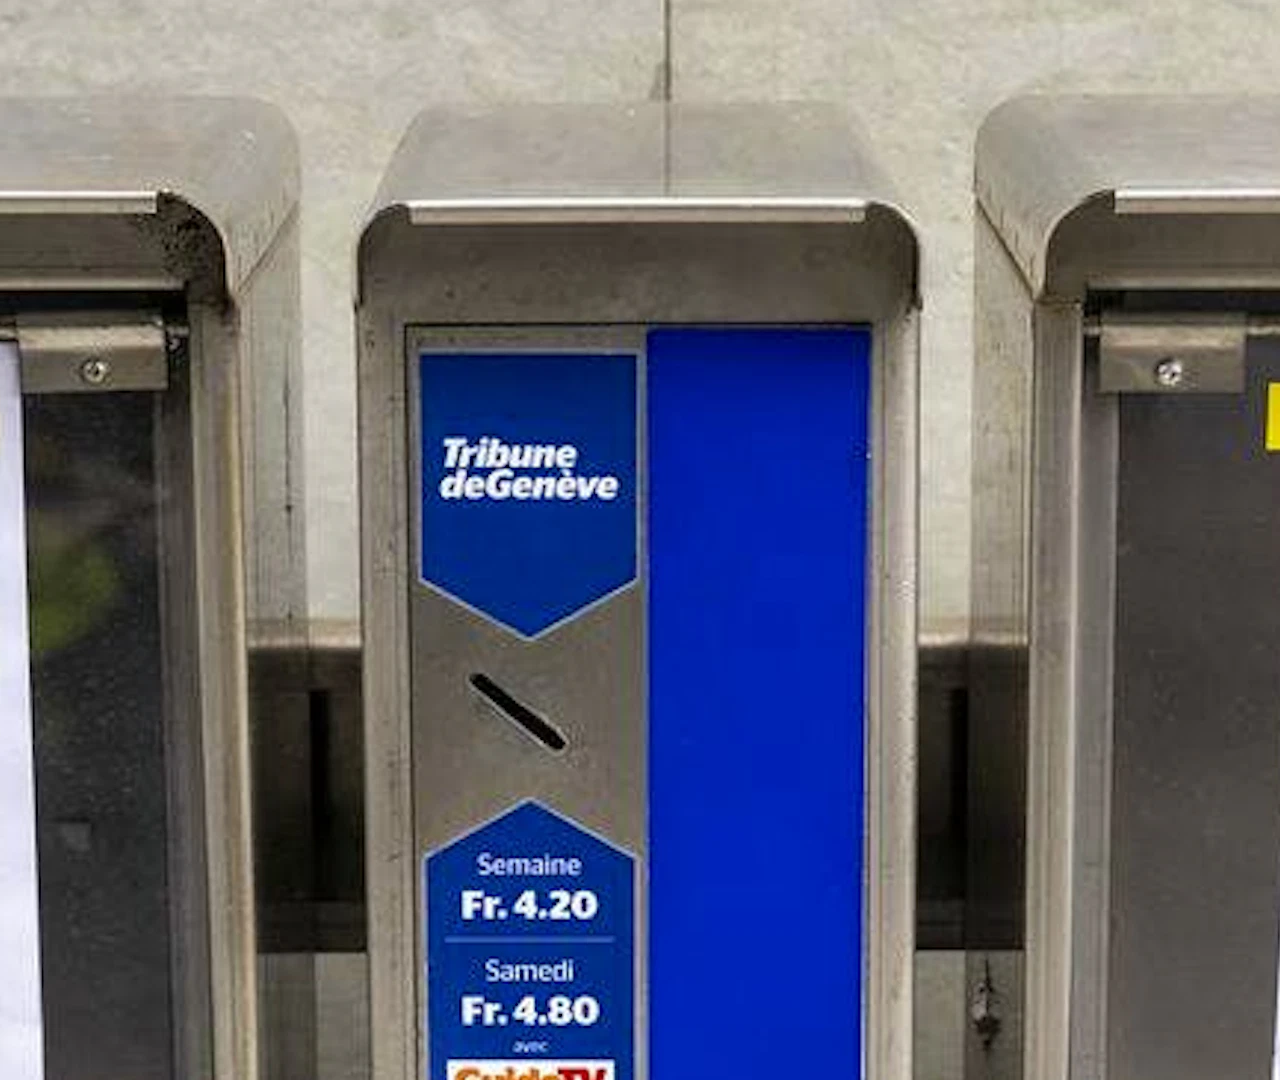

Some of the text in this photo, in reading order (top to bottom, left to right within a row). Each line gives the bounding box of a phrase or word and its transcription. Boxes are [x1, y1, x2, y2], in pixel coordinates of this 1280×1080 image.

[443, 437, 577, 468] Tribune
[440, 468, 618, 500] deGenève
[477, 853, 582, 876] Semaine
[461, 890, 598, 920] Fr. 4.20
[485, 958, 574, 982] Samedi
[461, 996, 600, 1026] Fr. 4.80
[513, 1041, 550, 1053] avec
